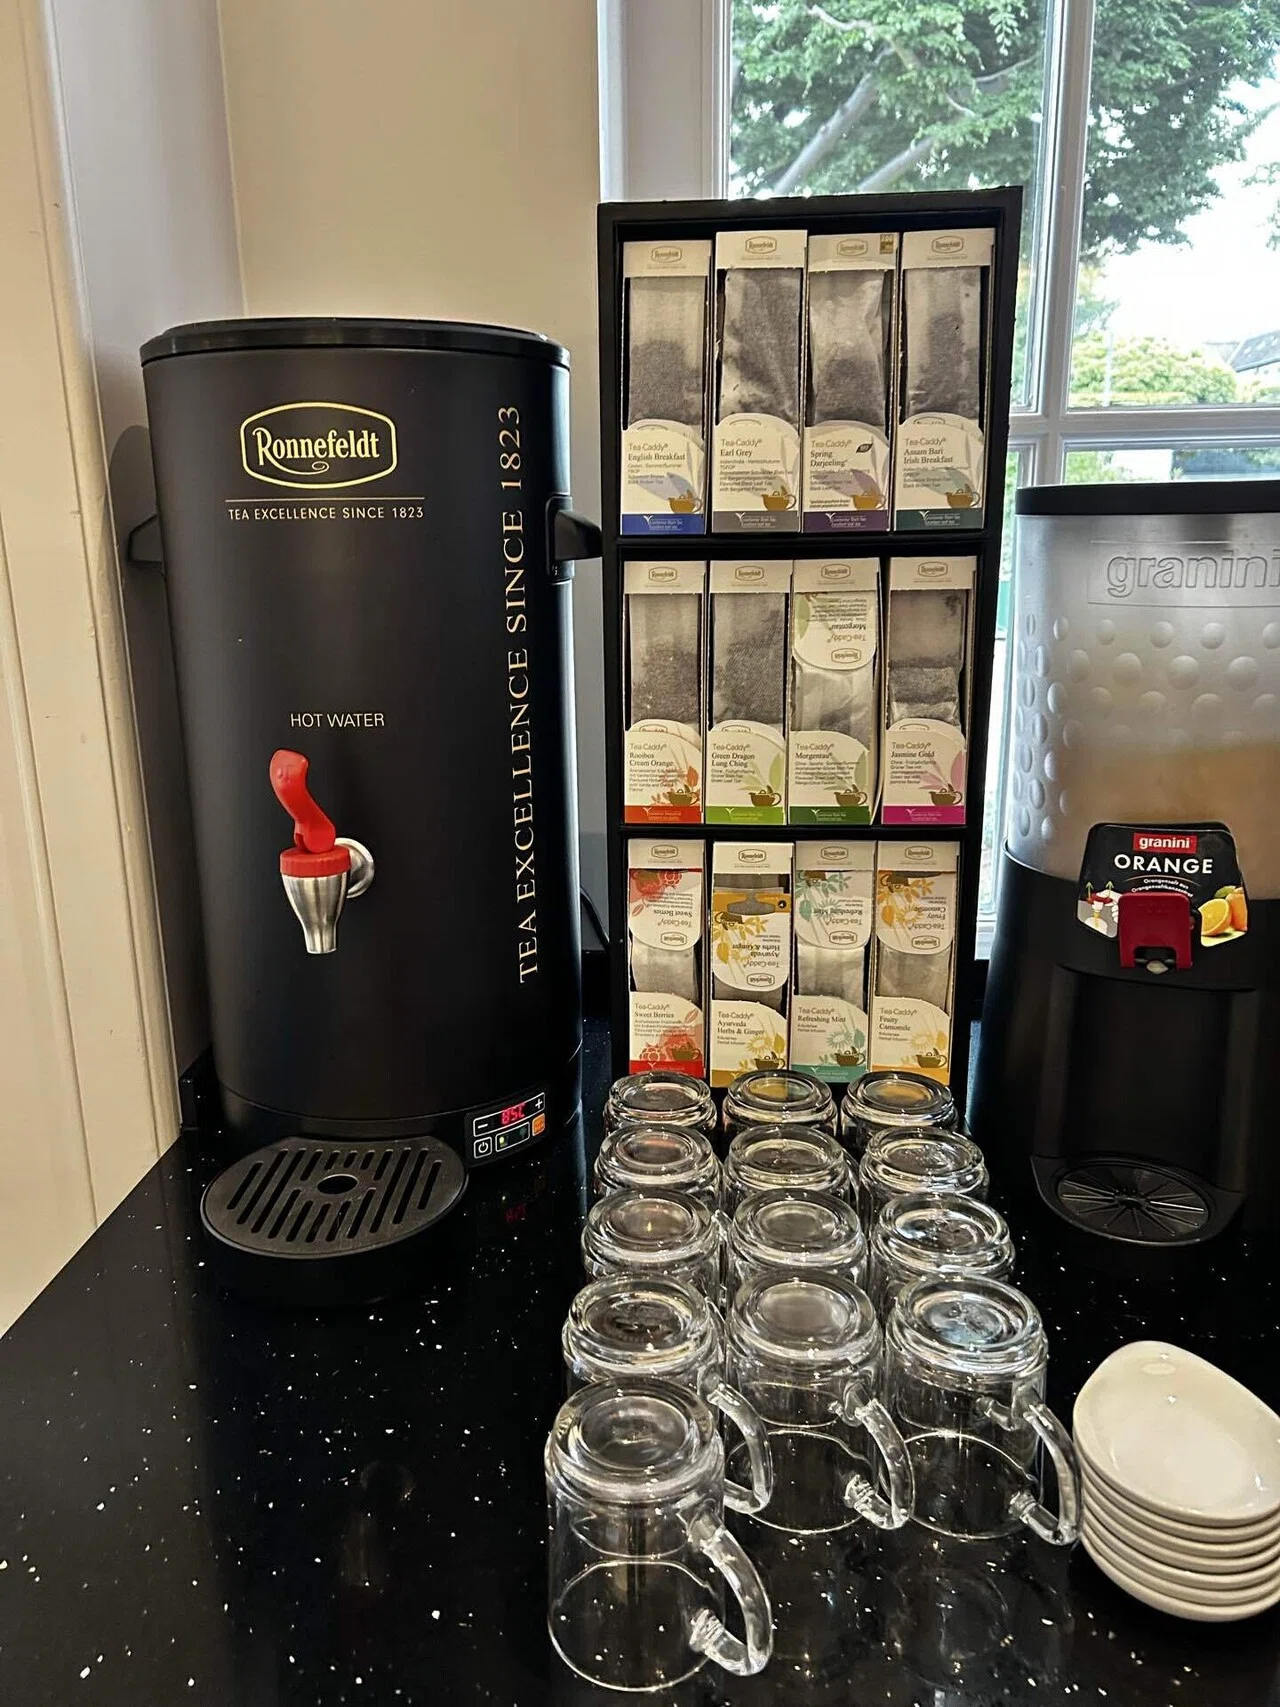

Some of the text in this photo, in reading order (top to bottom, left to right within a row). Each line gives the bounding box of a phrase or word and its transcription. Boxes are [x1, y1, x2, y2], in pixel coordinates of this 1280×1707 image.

[252, 427, 380, 475] Ronnefeldt
[720, 449, 753, 458] Earl Grey
[810, 451, 833, 459] Spring
[628, 453, 686, 462] English Breakfast
[921, 456, 953, 464] Breakfast
[229, 506, 424, 520] TEA EXCELLENCE SINCE 1823
[498, 406, 538, 983] TEA EXCELLENCE SINCE 1823
[290, 713, 385, 727] HOT WATER
[729, 760, 748, 768] Ching
[1139, 836, 1190, 850] granini
[1114, 854, 1213, 874] ORANGE
[1143, 878, 1179, 886] Orangensaft
[880, 1016, 898, 1024] Fruity
